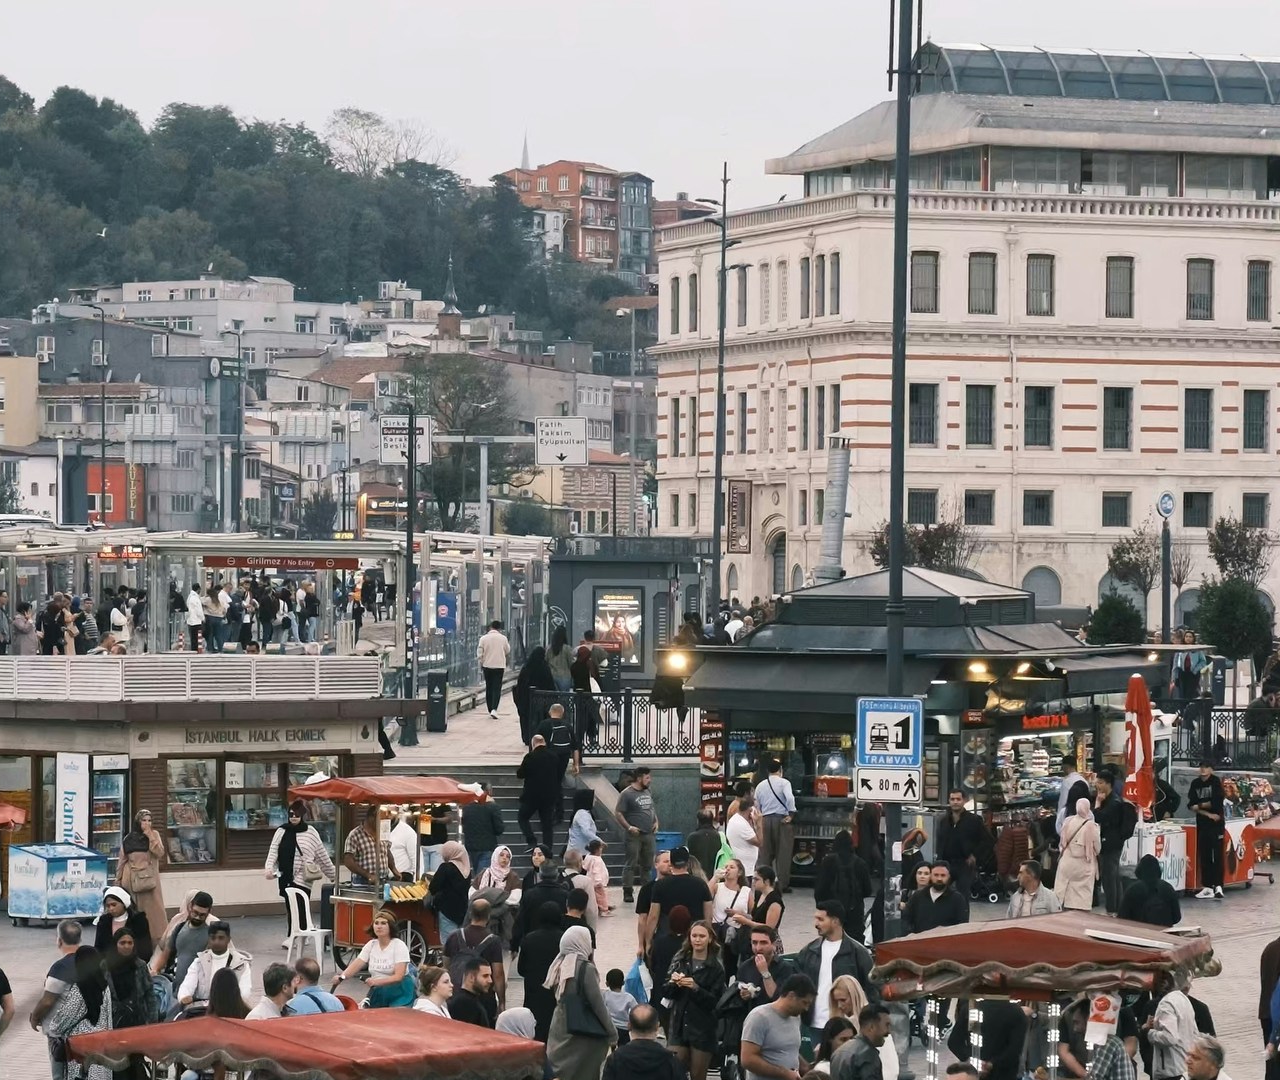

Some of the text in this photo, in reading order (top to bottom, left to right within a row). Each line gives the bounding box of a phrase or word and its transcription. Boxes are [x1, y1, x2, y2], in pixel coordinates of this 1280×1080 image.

[247, 557, 281, 565] Girilmez
[185, 728, 326, 743] İSTANBUL HALK EKMEK
[865, 755, 914, 764] TRAMVAY
[879, 779, 900, 791] 80 m
[64, 791, 76, 844] hami
